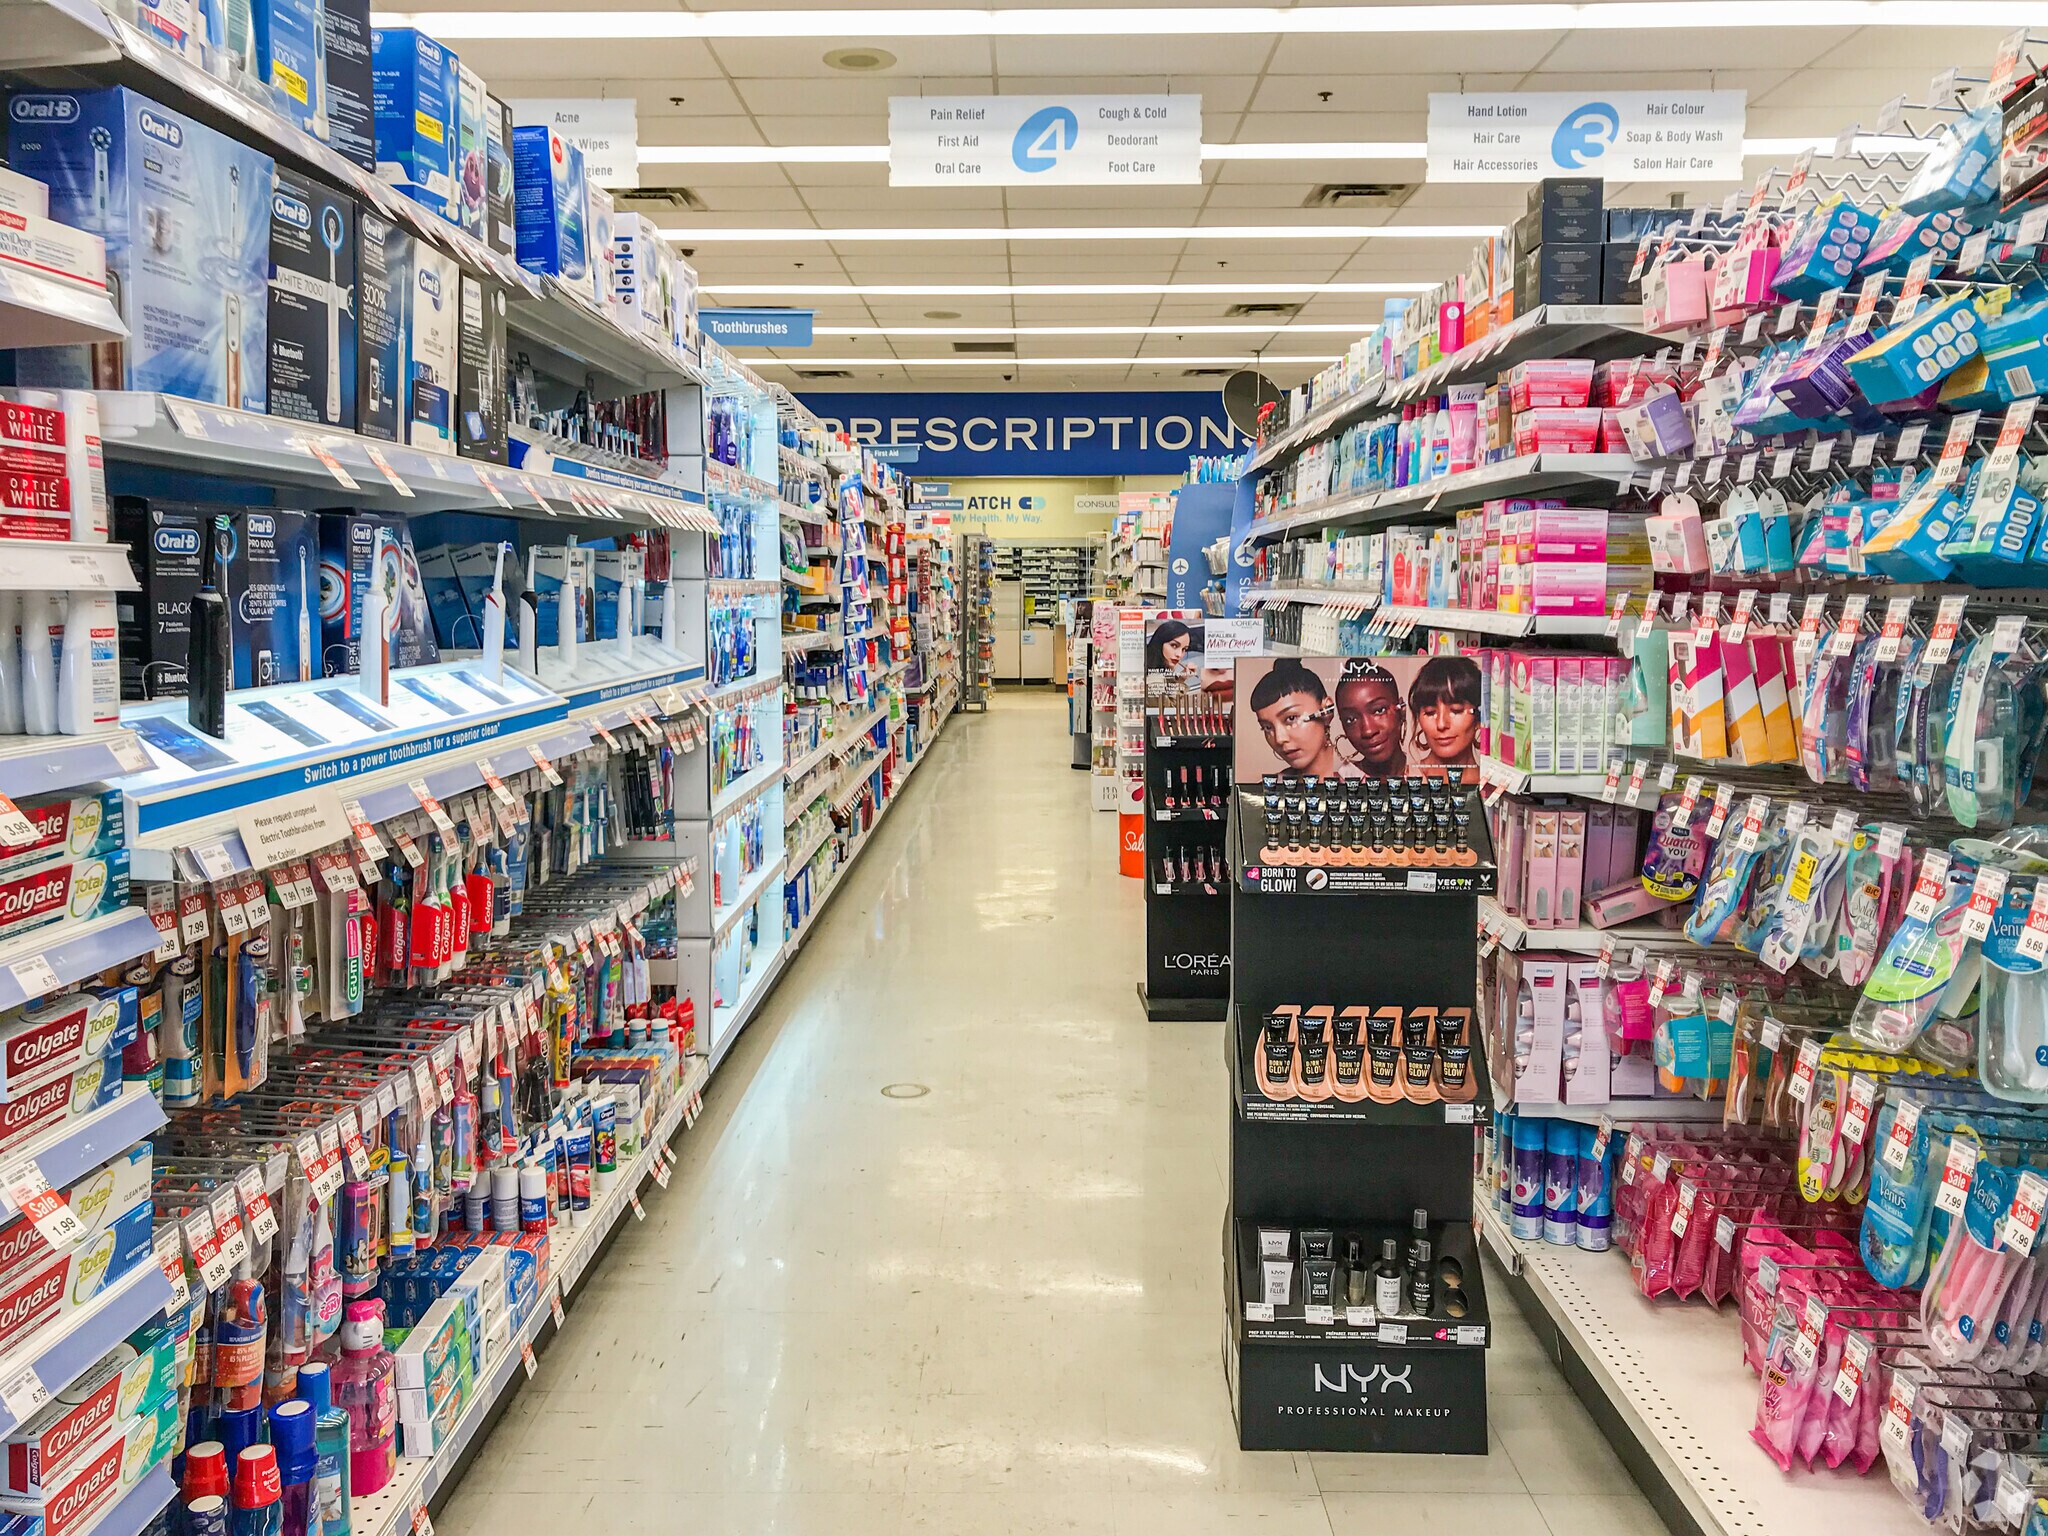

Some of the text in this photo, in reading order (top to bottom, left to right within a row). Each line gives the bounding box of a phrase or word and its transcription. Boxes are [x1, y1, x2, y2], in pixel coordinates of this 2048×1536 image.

[15, 100, 72, 118] Oral-B
[555, 112, 580, 122] Acne
[930, 108, 985, 120] Pain Relief
[1099, 107, 1167, 121] Cough & Cold
[1468, 105, 1527, 117] Hand Lotion
[1647, 103, 1704, 115] Hair Colour
[141, 117, 180, 144] Oral-B
[1474, 132, 1520, 143] Hair Care
[1627, 130, 1723, 144] Soap & Body Wash
[579, 138, 609, 151] Wipes
[938, 135, 979, 147] First Aid
[1027, 119, 1072, 170] 4
[1107, 134, 1158, 146] Deodorant
[586, 164, 612, 178] giene
[935, 163, 981, 174] Oral Care
[1109, 161, 1155, 173] Foot Care
[1453, 159, 1538, 171] Hair Accessories
[1633, 157, 1713, 169] Salon Hair Care
[275, 198, 307, 223] Oral-B
[304, 281, 323, 297] 7000
[711, 320, 788, 335] Toothbrushes
[1455, 390, 1477, 400] Nair
[7, 409, 53, 426] OPTIC
[9, 421, 54, 442] WHITE
[819, 417, 1252, 452] PRESCRIPTION
[2001, 430, 2021, 444] Sale
[1946, 444, 1963, 457] Sale
[1992, 454, 2013, 467] 19.99
[9, 478, 58, 492] OPTIC
[10, 489, 57, 508] WHITE
[967, 496, 1011, 510] ATCH
[249, 519, 272, 532] Oral-B
[953, 513, 1043, 524] My Health. My Way.
[158, 533, 196, 549] Oral-B
[249, 540, 274, 548] PRO 6000
[157, 602, 191, 614] BLACK
[158, 622, 165, 634] 7
[1885, 624, 1900, 638] Sale
[1935, 625, 1953, 639] Sale
[1930, 647, 1950, 658] 16.99
[1339, 661, 1379, 675] NYX
[304, 762, 337, 784] Switch
[340, 760, 349, 773] to
[353, 760, 358, 770] a
[361, 752, 386, 772] power
[390, 741, 432, 761] toothbrush
[434, 737, 444, 749] for
[445, 737, 451, 746] a
[452, 727, 479, 745] superior
[73, 812, 100, 832] Total
[254, 804, 317, 828] Please request unopened
[4, 821, 31, 837] 3.99
[260, 820, 326, 844] Electric Toothbrushes from
[1657, 834, 1700, 850] Quattro
[1743, 837, 1755, 847] 9.99
[267, 848, 297, 863] the Cashier
[1668, 847, 1687, 857] YOU
[1261, 868, 1297, 878] BORN TO
[243, 882, 261, 900] Sale
[1260, 879, 1297, 892] GLOW!
[1919, 879, 1936, 896] Sale
[184, 896, 202, 914] Sale
[220, 891, 238, 908] Sale
[1974, 896, 1991, 913] Sale
[251, 904, 267, 920] 7.99
[1913, 901, 1930, 915] 7.49
[188, 920, 206, 936] 7.99
[228, 913, 244, 928] 7.99
[459, 902, 467, 944] Colgate
[1968, 919, 1986, 932] 7.99
[433, 915, 441, 960] Colgate
[442, 912, 450, 954] Colgate
[363, 923, 372, 969] Colgate
[394, 921, 406, 962] Colgate
[2025, 938, 2043, 952] 9.69
[1164, 953, 1231, 969] L'ORÉA
[13, 1023, 80, 1064] Colgate
[2039, 1049, 2047, 1062] 2
[4, 1082, 67, 1125] Colgate
[1895, 1126, 1909, 1144] Sale
[1890, 1147, 1903, 1162] 7.99
[1948, 1169, 1966, 1189] Sale
[1880, 1175, 1907, 1210] Venus
[28, 1194, 58, 1219] Sale
[249, 1196, 268, 1218] Sale
[1945, 1193, 1962, 1209] 7.99
[2016, 1204, 2034, 1227] Sale
[52, 1217, 77, 1237] 1.99
[220, 1220, 238, 1241] Sale
[258, 1218, 274, 1236] 5.99
[2012, 1229, 2029, 1248] 7.99
[198, 1243, 217, 1264] Sale
[229, 1240, 245, 1259] 5.99
[209, 1263, 226, 1281] 5.99
[1314, 1363, 1413, 1393] NYX
[1769, 1370, 1783, 1384] BIC
[1844, 1361, 1858, 1381] Sale
[33, 1388, 47, 1403] 6.79
[1839, 1381, 1853, 1397] 7.99
[1278, 1406, 1451, 1417] PROFESSIONAL MAKEUP
[1893, 1400, 1908, 1422] Sale
[46, 1395, 114, 1458] Colgate
[1890, 1423, 1904, 1440] 7.99
[51, 1457, 120, 1522] Colgate
